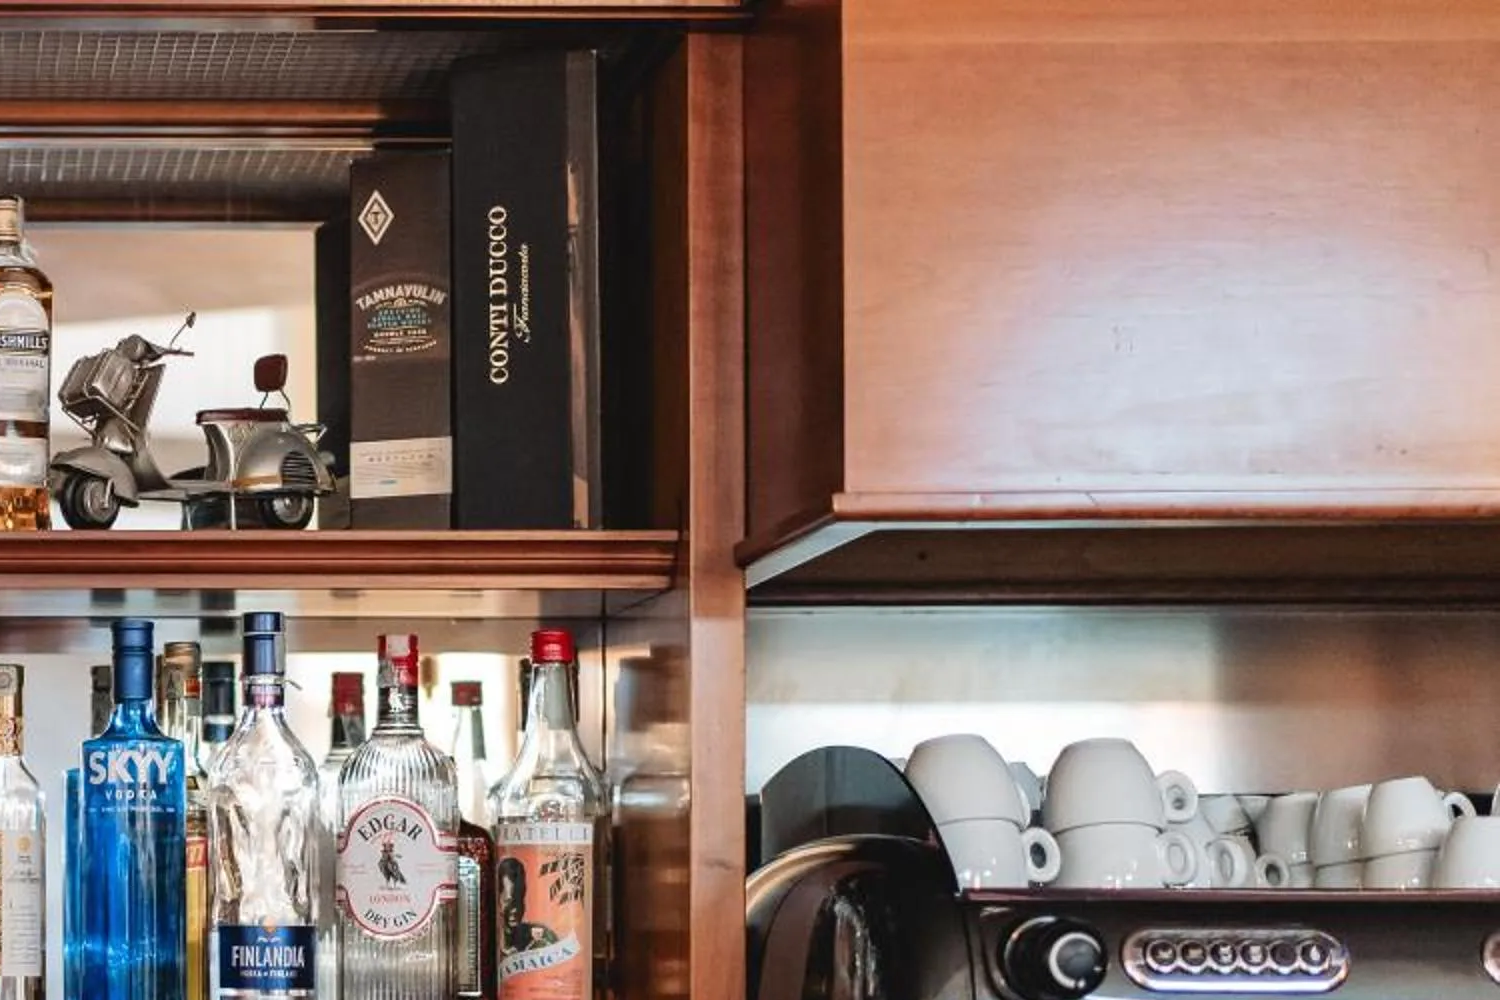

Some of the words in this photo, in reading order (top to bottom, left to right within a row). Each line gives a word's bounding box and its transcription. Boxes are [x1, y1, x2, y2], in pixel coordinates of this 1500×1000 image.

[488, 205, 508, 298] DUCCO
[356, 284, 446, 310] TAMNAVULIN
[489, 303, 509, 384] CONTI
[89, 750, 174, 785] SKYY
[105, 789, 157, 801] VODKA
[357, 814, 423, 841] EDGAR
[364, 909, 388, 928] DRY
[393, 910, 417, 927] GIN
[231, 945, 305, 968] FINLANDIA
